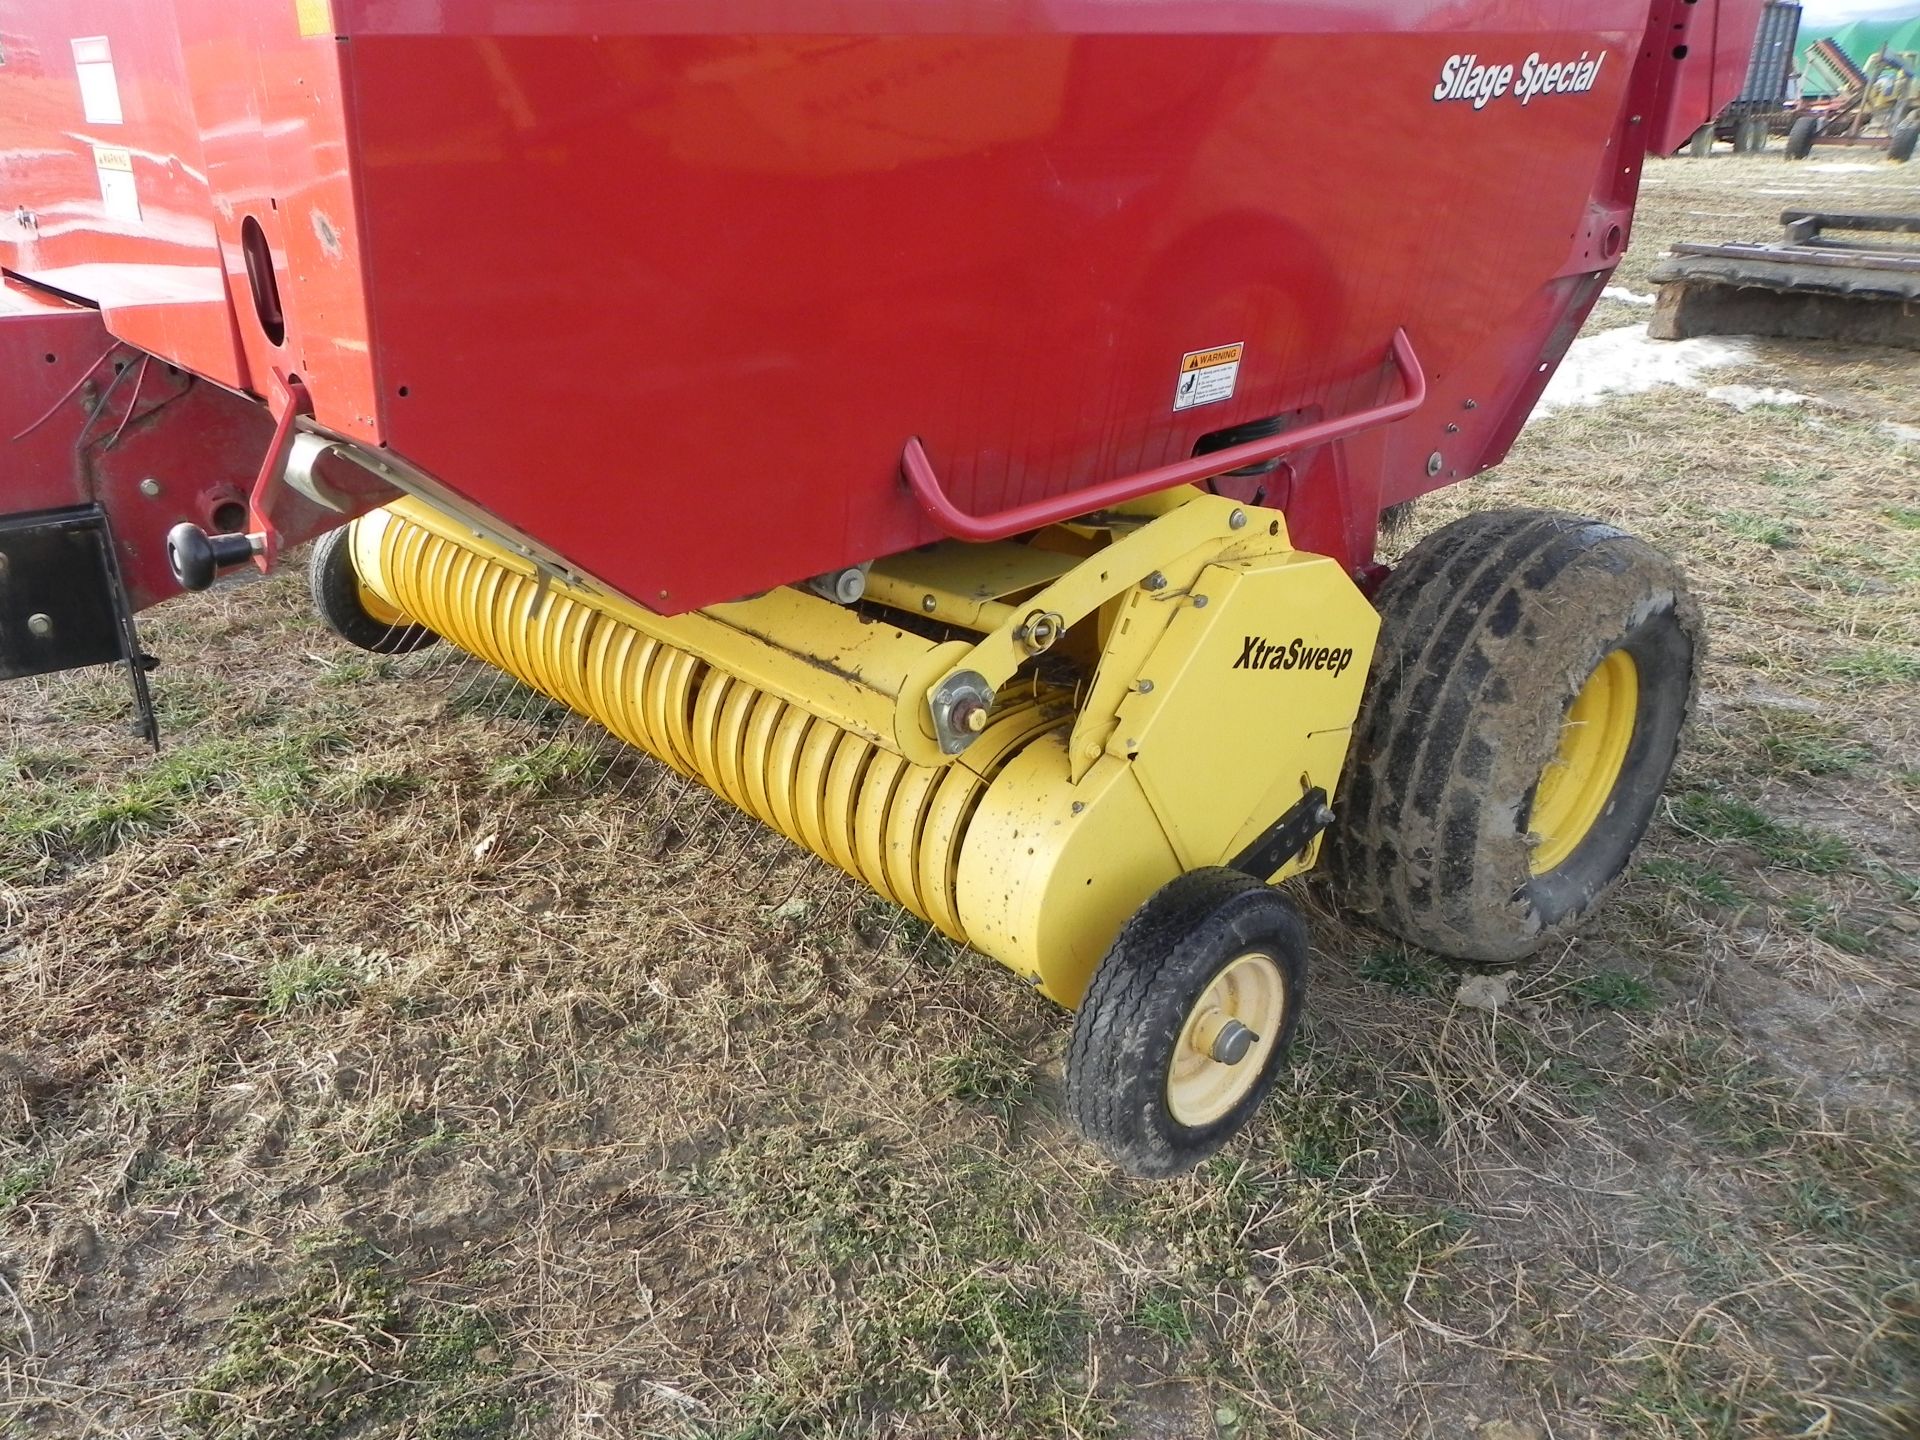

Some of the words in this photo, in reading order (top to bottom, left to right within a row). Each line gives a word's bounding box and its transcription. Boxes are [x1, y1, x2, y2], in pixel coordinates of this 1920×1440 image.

[1433, 54, 1514, 110] Silage
[1513, 51, 1607, 107] Special
[1200, 349, 1237, 364] WARNING
[1232, 636, 1353, 678] XtraSweep
